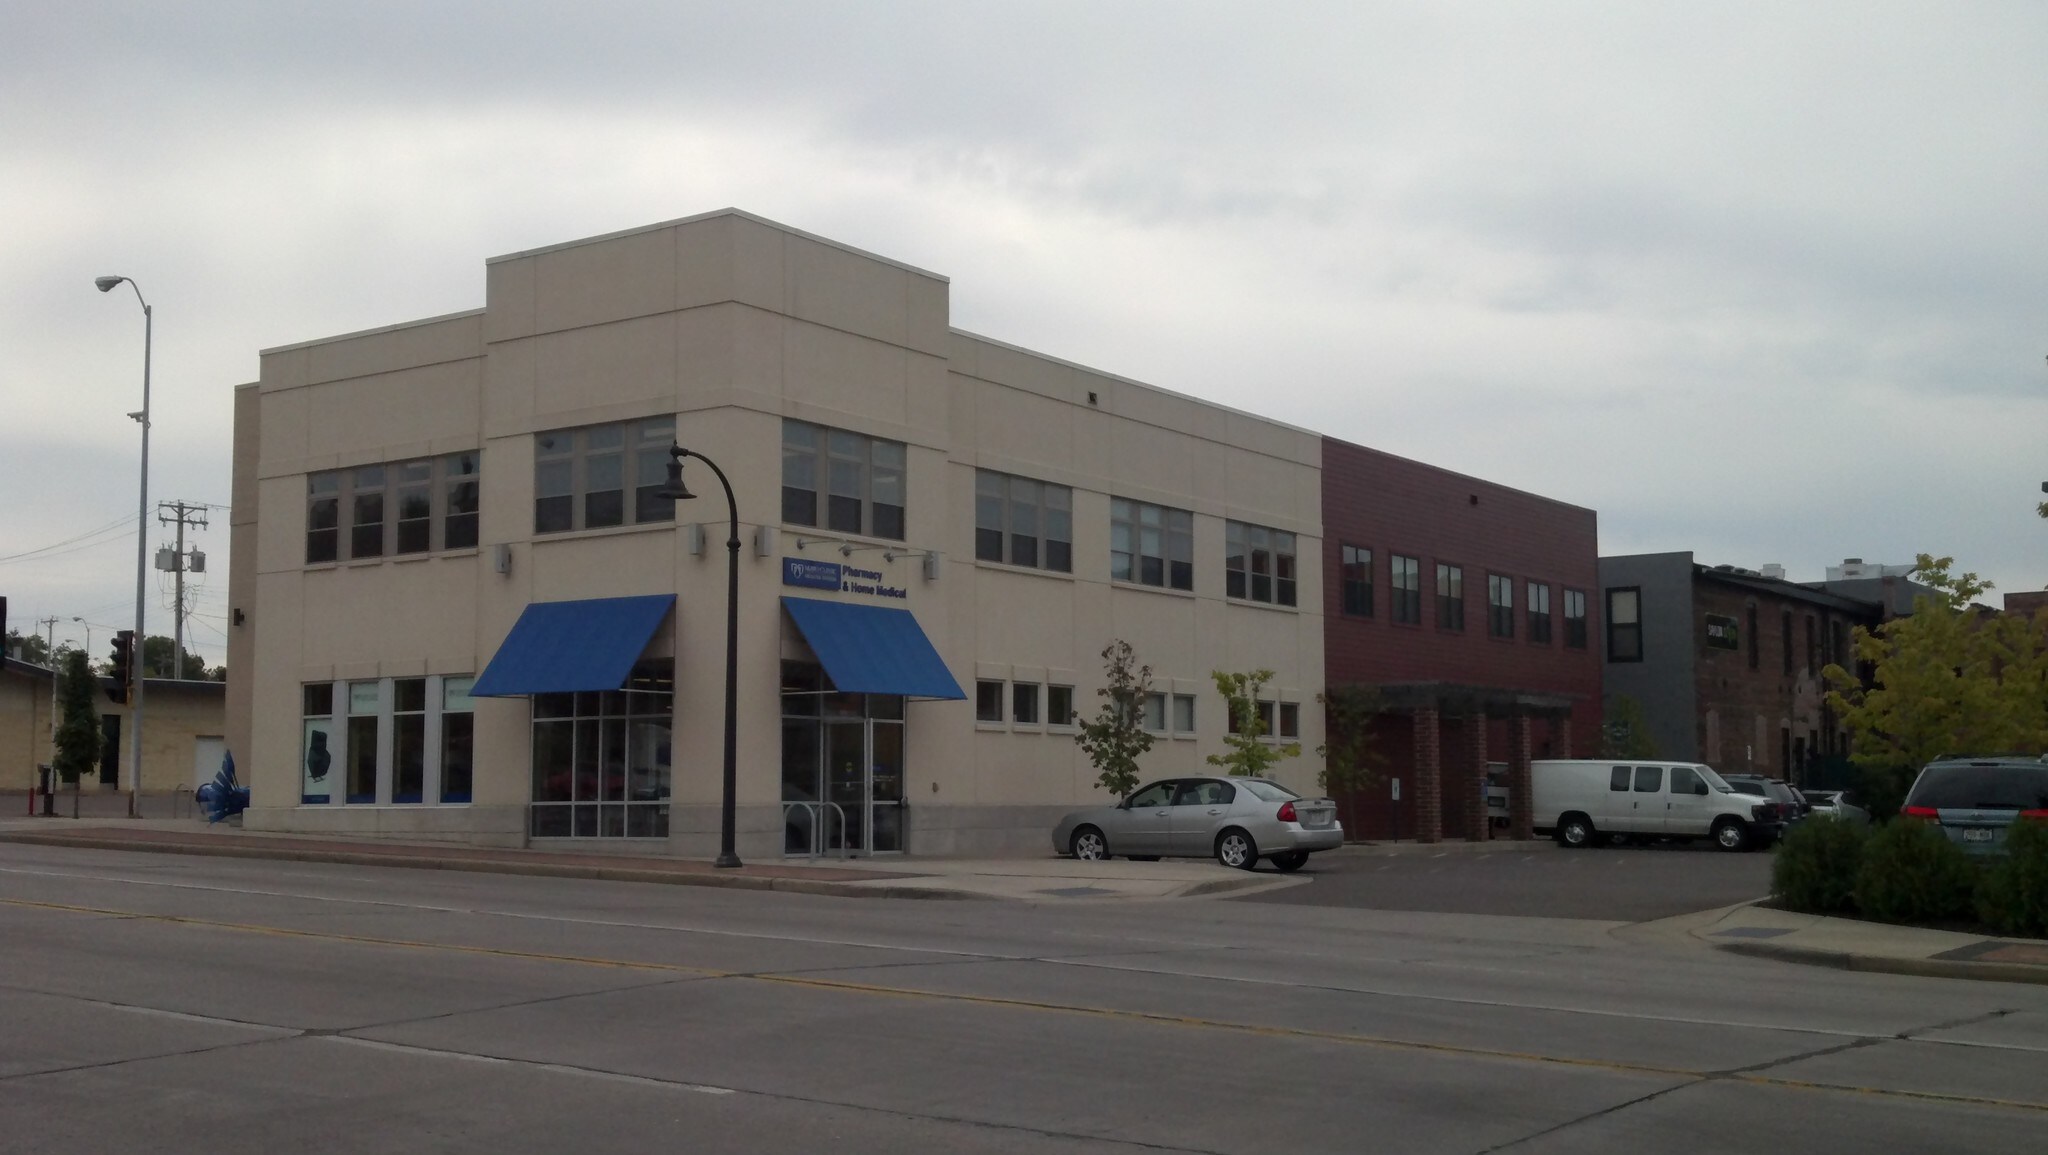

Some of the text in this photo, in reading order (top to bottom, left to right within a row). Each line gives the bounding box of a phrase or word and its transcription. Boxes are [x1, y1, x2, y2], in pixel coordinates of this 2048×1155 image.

[842, 565, 882, 583] Pharmacy
[842, 581, 907, 599] & Home Medical
